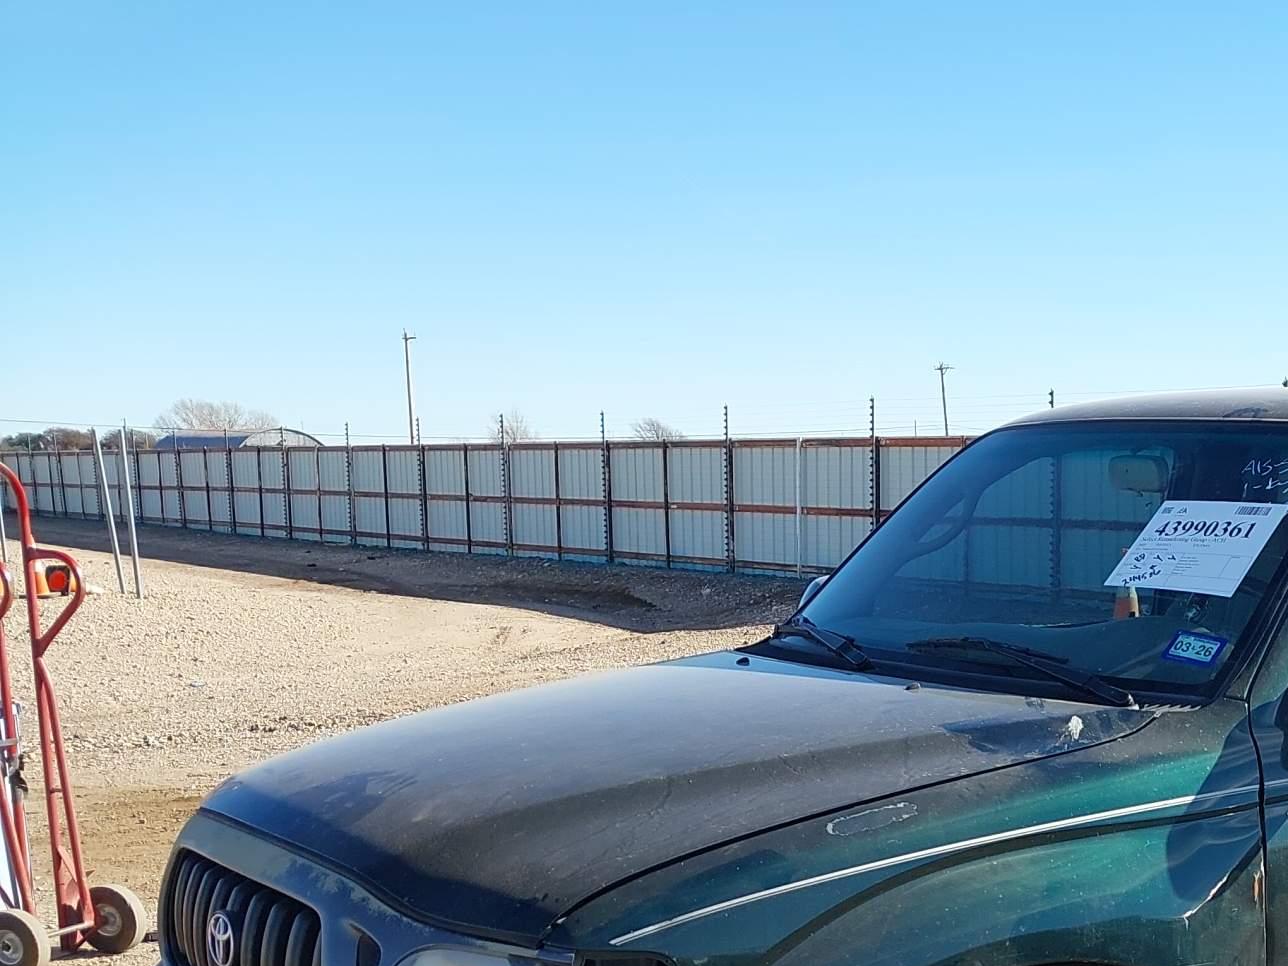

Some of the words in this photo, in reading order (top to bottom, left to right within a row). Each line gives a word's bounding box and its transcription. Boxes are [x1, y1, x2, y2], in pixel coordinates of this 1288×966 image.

[1154, 520, 1256, 538] 43990361
[1174, 640, 1192, 653] 03
[1195, 645, 1214, 657] 26
